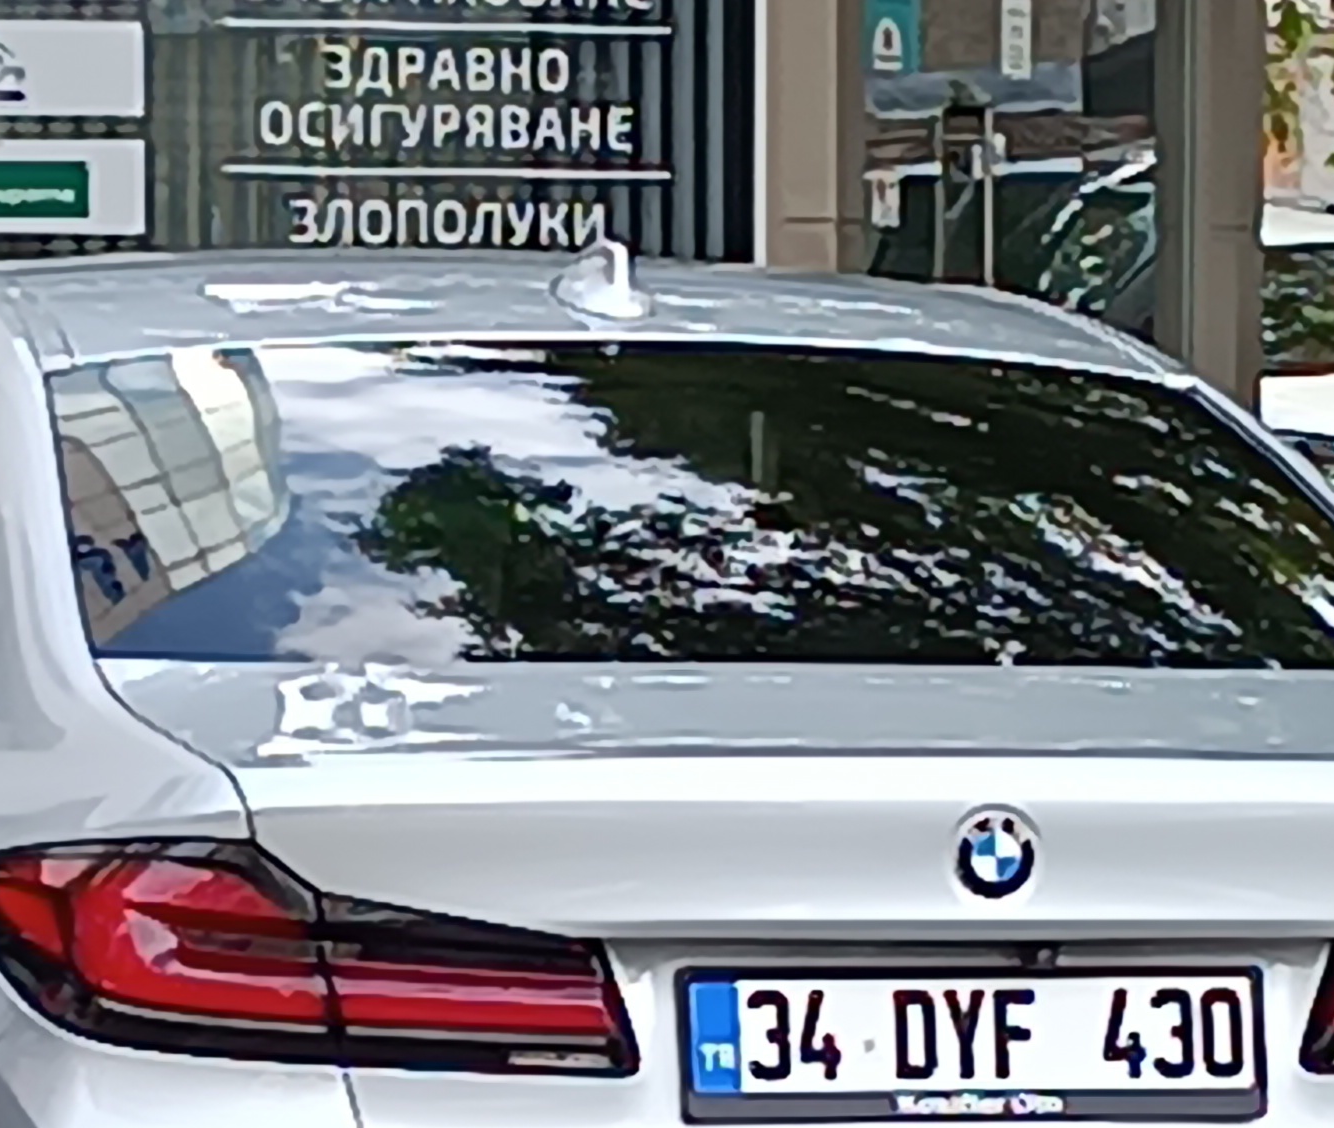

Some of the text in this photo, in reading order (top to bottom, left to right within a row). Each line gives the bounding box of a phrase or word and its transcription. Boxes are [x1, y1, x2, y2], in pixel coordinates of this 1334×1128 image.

[322, 43, 570, 98] ЗДРАВНО
[259, 100, 635, 153] ОСИГУРЯВАНЕ
[288, 198, 607, 247] ЗЛОПОЛУКИ
[698, 1042, 735, 1072] TR
[746, 987, 1245, 1081] 34 DYF 430
